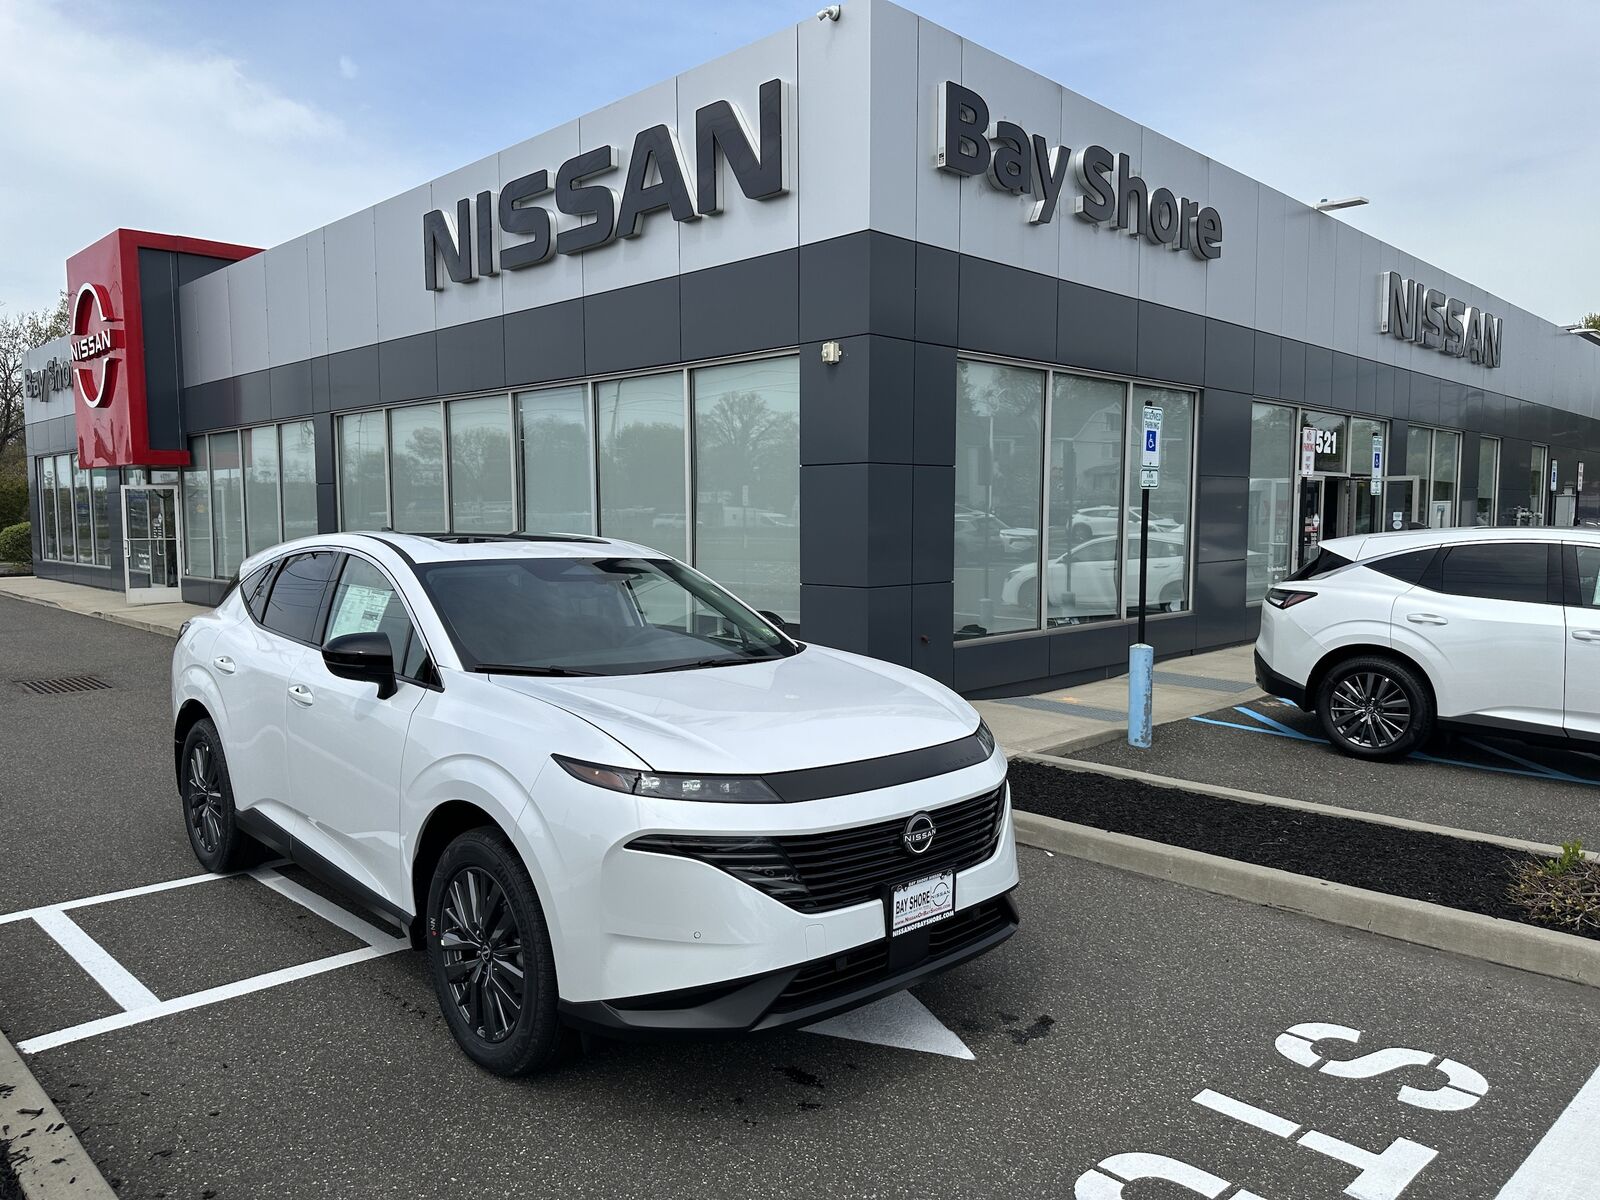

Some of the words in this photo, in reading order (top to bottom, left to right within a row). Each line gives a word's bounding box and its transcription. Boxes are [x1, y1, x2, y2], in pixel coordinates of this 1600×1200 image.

[424, 78, 788, 291] NISSAN
[939, 80, 1071, 225] Bay
[1075, 145, 1222, 260] Shore
[1382, 271, 1502, 368] NISSAN
[70, 328, 111, 361] NISSAN
[25, 368, 49, 402] Bay
[1315, 431, 1337, 454] 521
[904, 827, 936, 842] NISSAN
[895, 897, 909, 915] BAY
[909, 890, 930, 910] SHORE
[930, 889, 951, 899] NISSAN
[892, 910, 955, 938] NISSANOFBAYSHORE.COM
